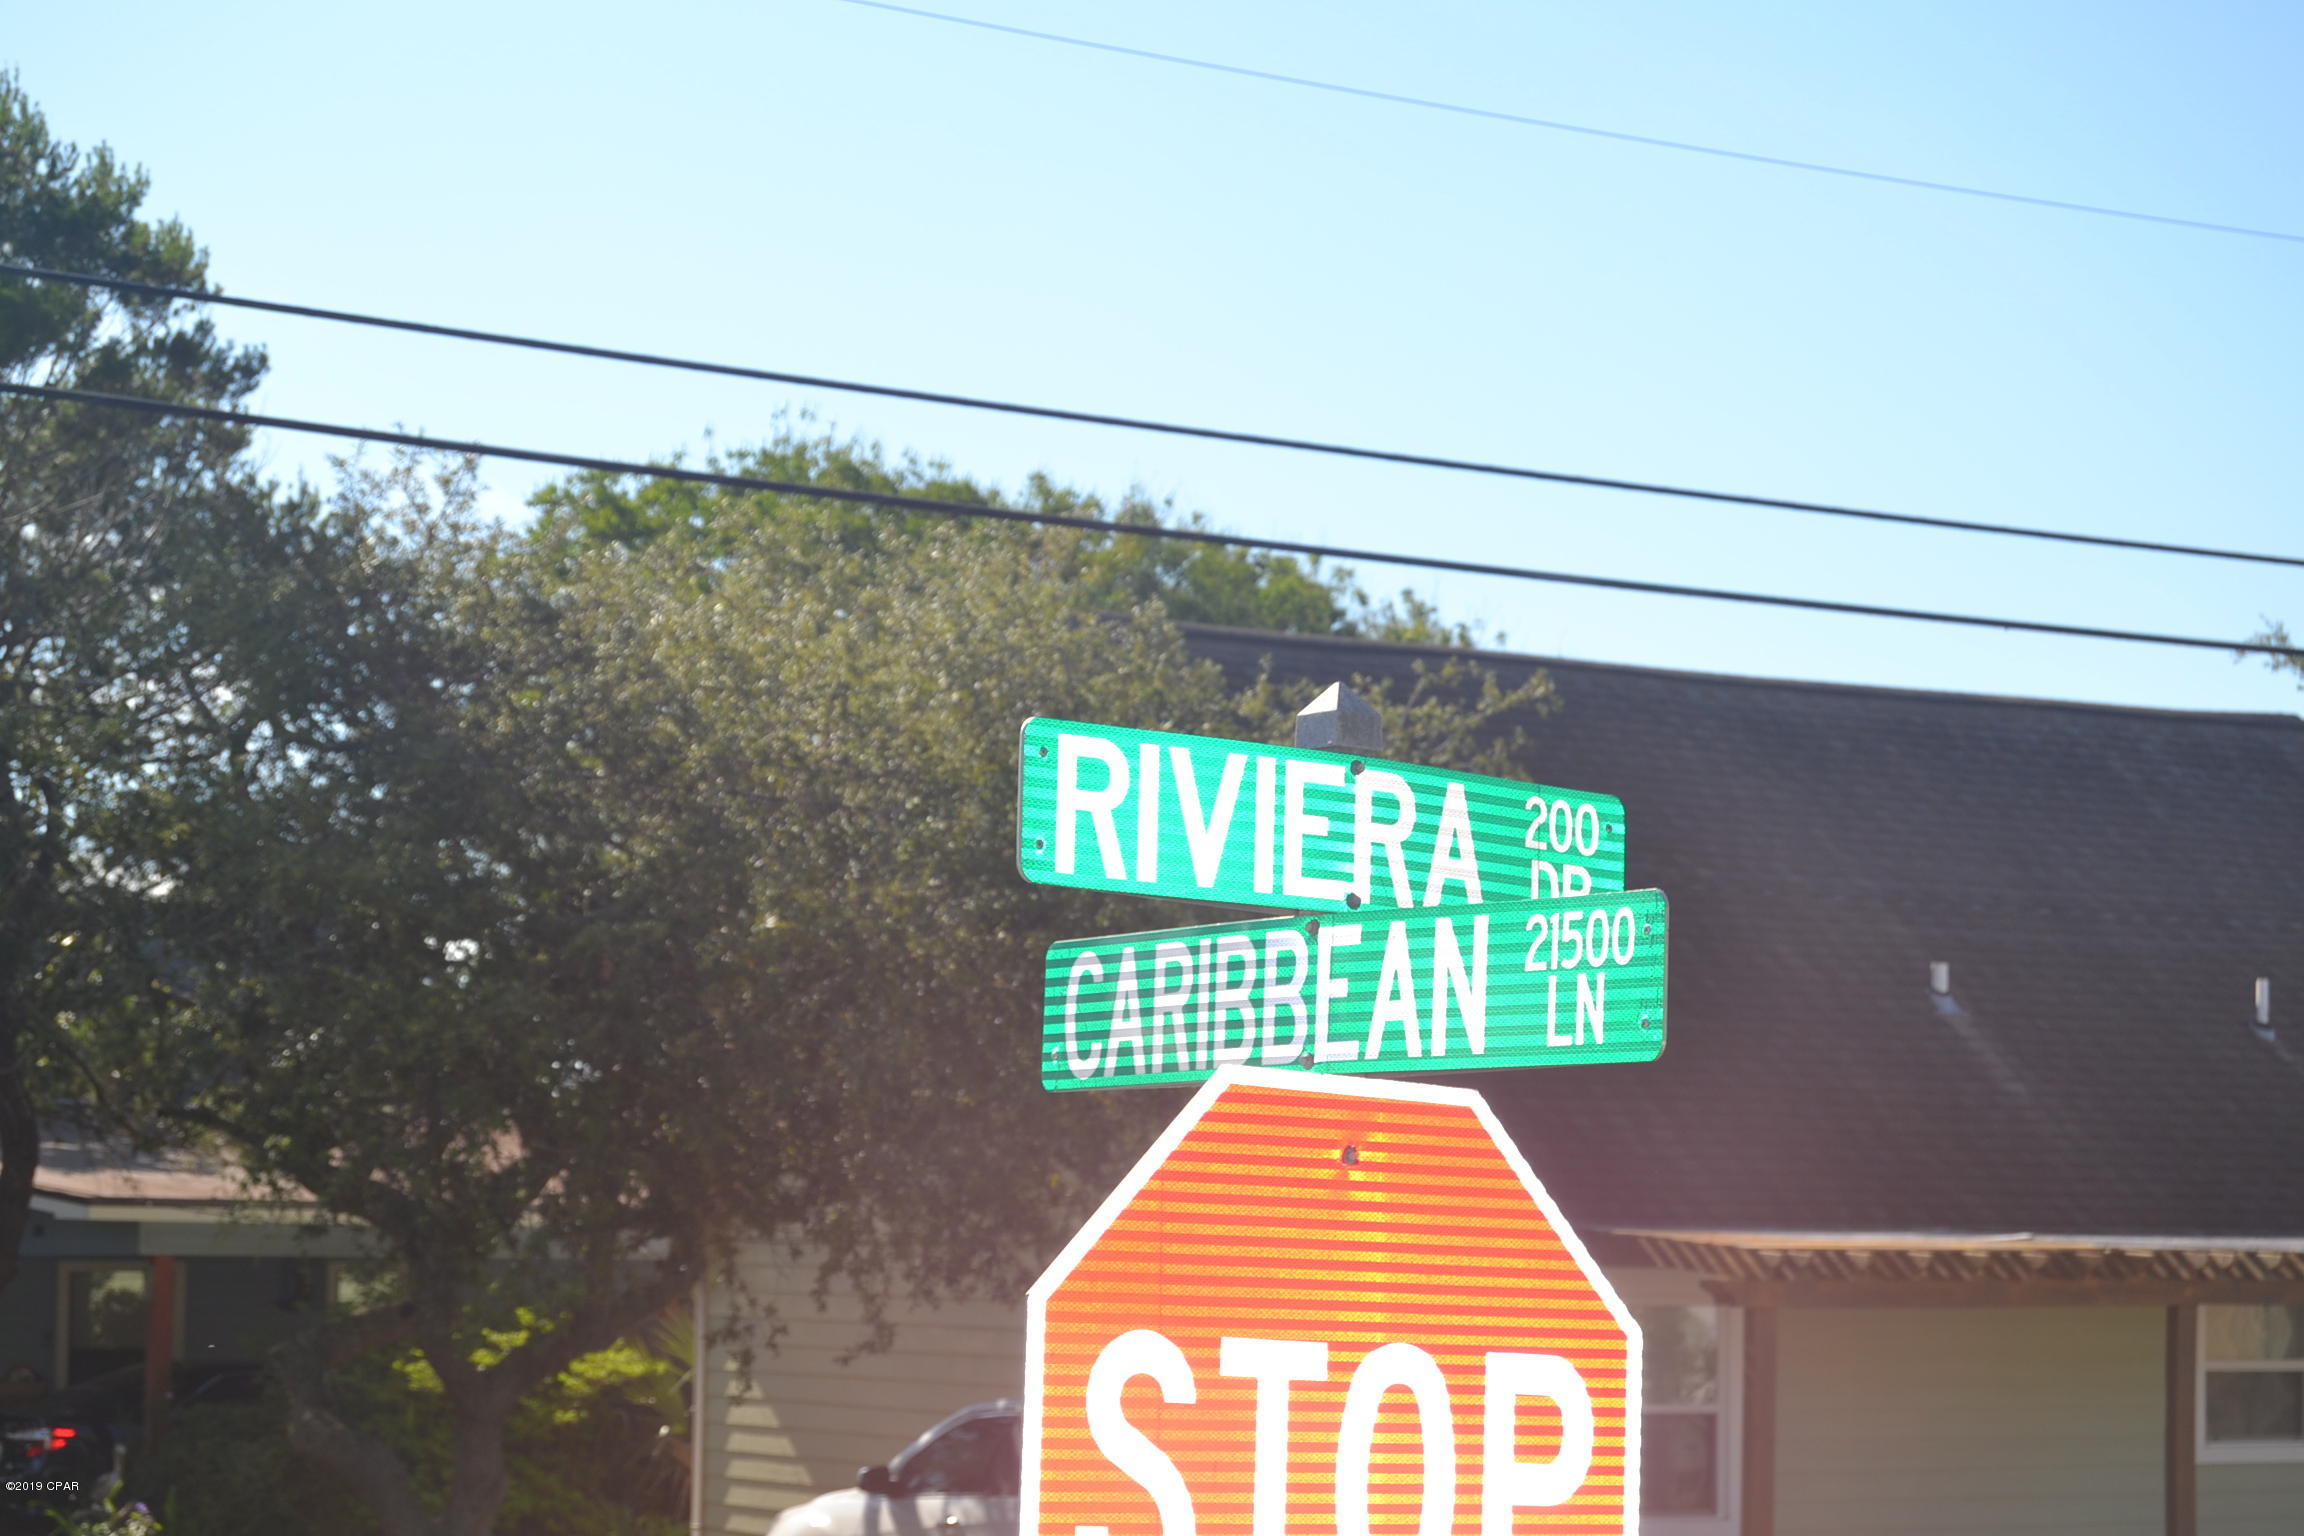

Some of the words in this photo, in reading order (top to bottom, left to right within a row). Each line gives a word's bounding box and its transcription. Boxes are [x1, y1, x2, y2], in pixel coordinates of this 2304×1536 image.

[1054, 733, 1483, 908] RIVIERA
[1524, 795, 1599, 856] 200
[1064, 915, 1489, 1080] CARIBBEAN
[1524, 907, 1635, 972] 21500
[1546, 972, 1605, 1047] LN
[1074, 1328, 1595, 1536] STOP
